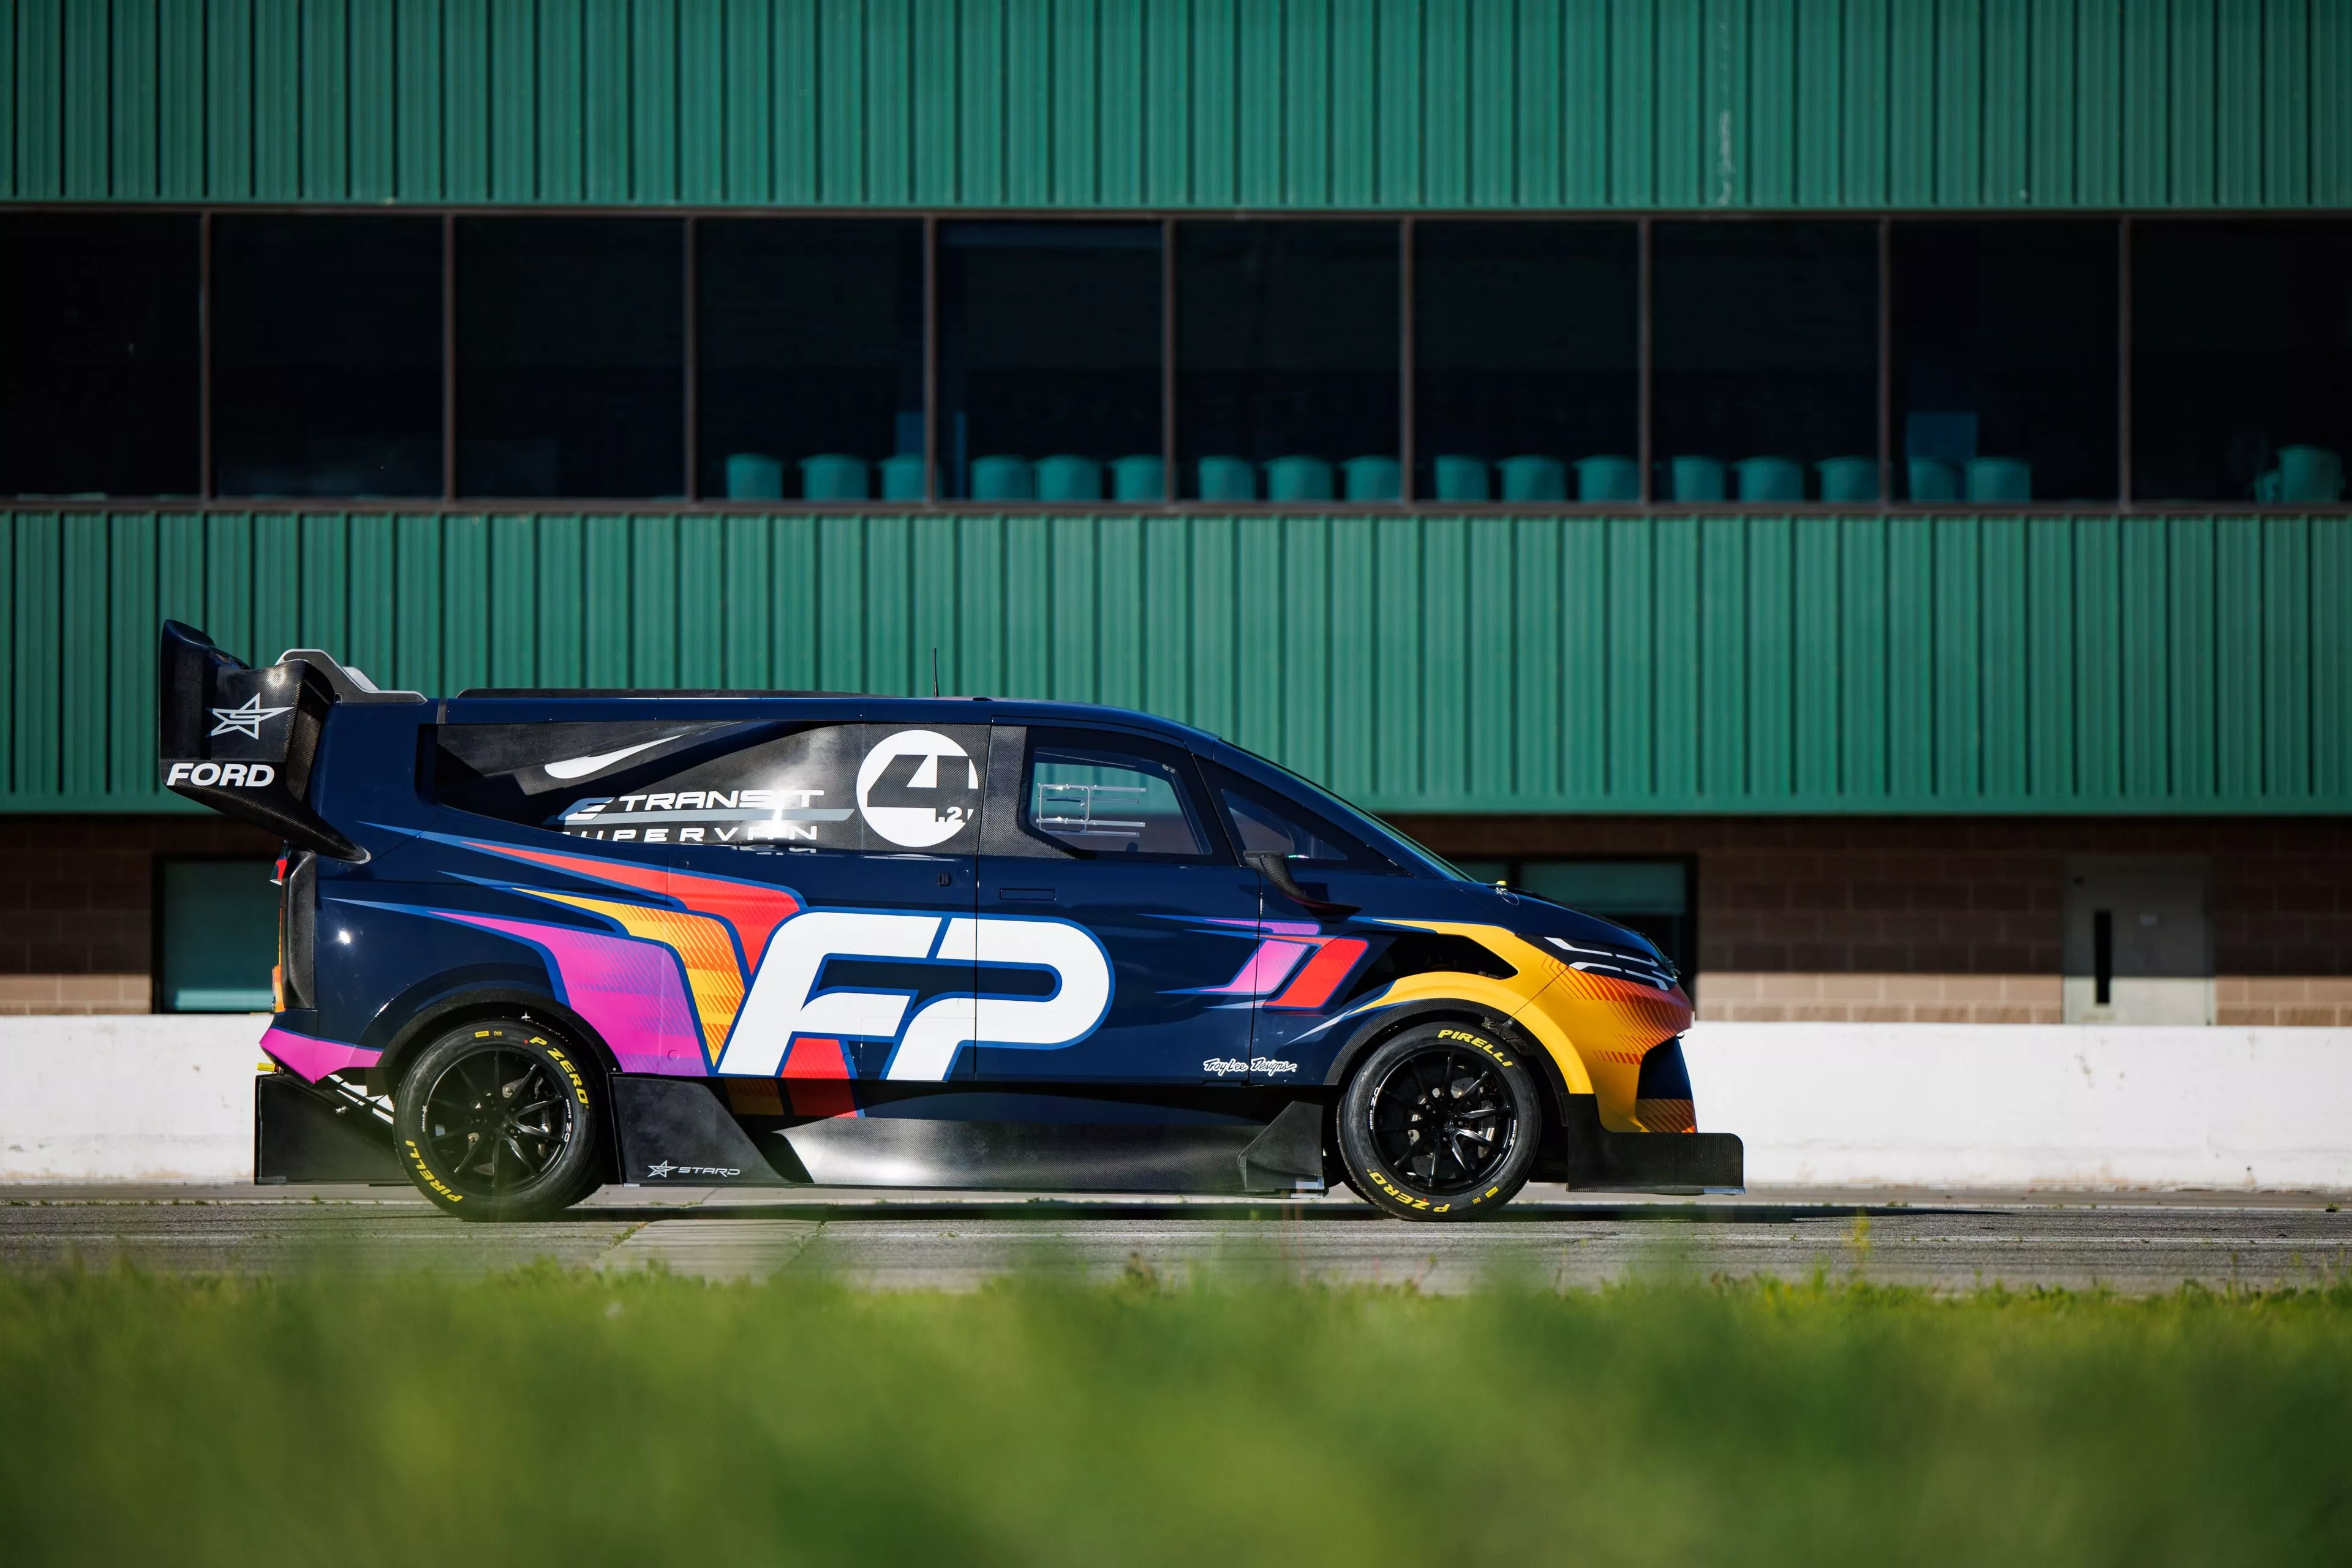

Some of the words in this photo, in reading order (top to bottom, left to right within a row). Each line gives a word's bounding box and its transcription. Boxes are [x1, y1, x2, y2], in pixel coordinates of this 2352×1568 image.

[166, 763, 275, 787] FORD
[618, 790, 824, 812] TRANST
[717, 911, 1110, 1082] FP
[1438, 1029, 1514, 1068] PIRELLI
[529, 1035, 548, 1046] P
[546, 1047, 589, 1105] ZERO
[1203, 1058, 1226, 1077] Troy
[1226, 1058, 1249, 1072] Lee
[1250, 1057, 1298, 1077] Designs
[405, 1140, 464, 1203] PIRELLI
[678, 1166, 741, 1177] STARD
[1369, 1172, 1430, 1210] ZERO
[1433, 1203, 1451, 1213] P
